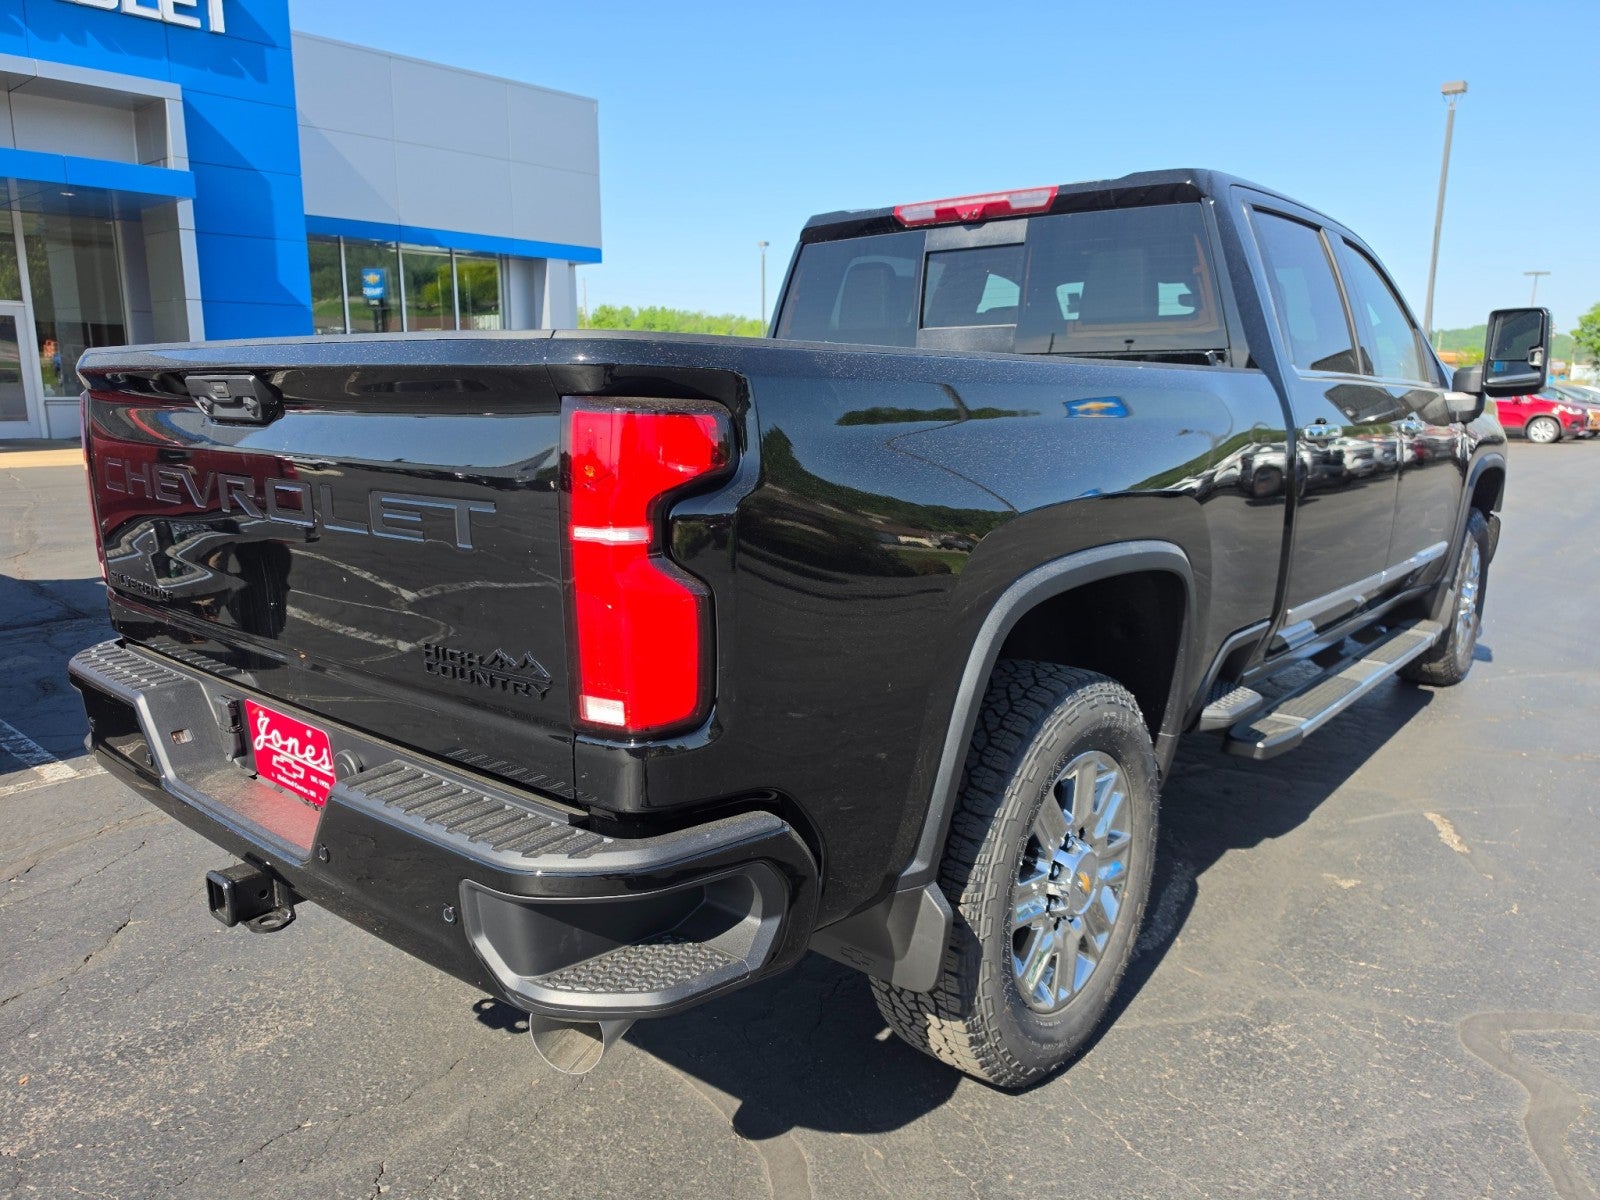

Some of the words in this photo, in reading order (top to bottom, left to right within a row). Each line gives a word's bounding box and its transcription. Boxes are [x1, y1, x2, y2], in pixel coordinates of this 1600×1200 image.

[103, 457, 497, 549] CHEVROLET
[423, 642, 485, 666] HIGH
[424, 660, 553, 700] COUNTRY
[254, 712, 334, 770] Jones
